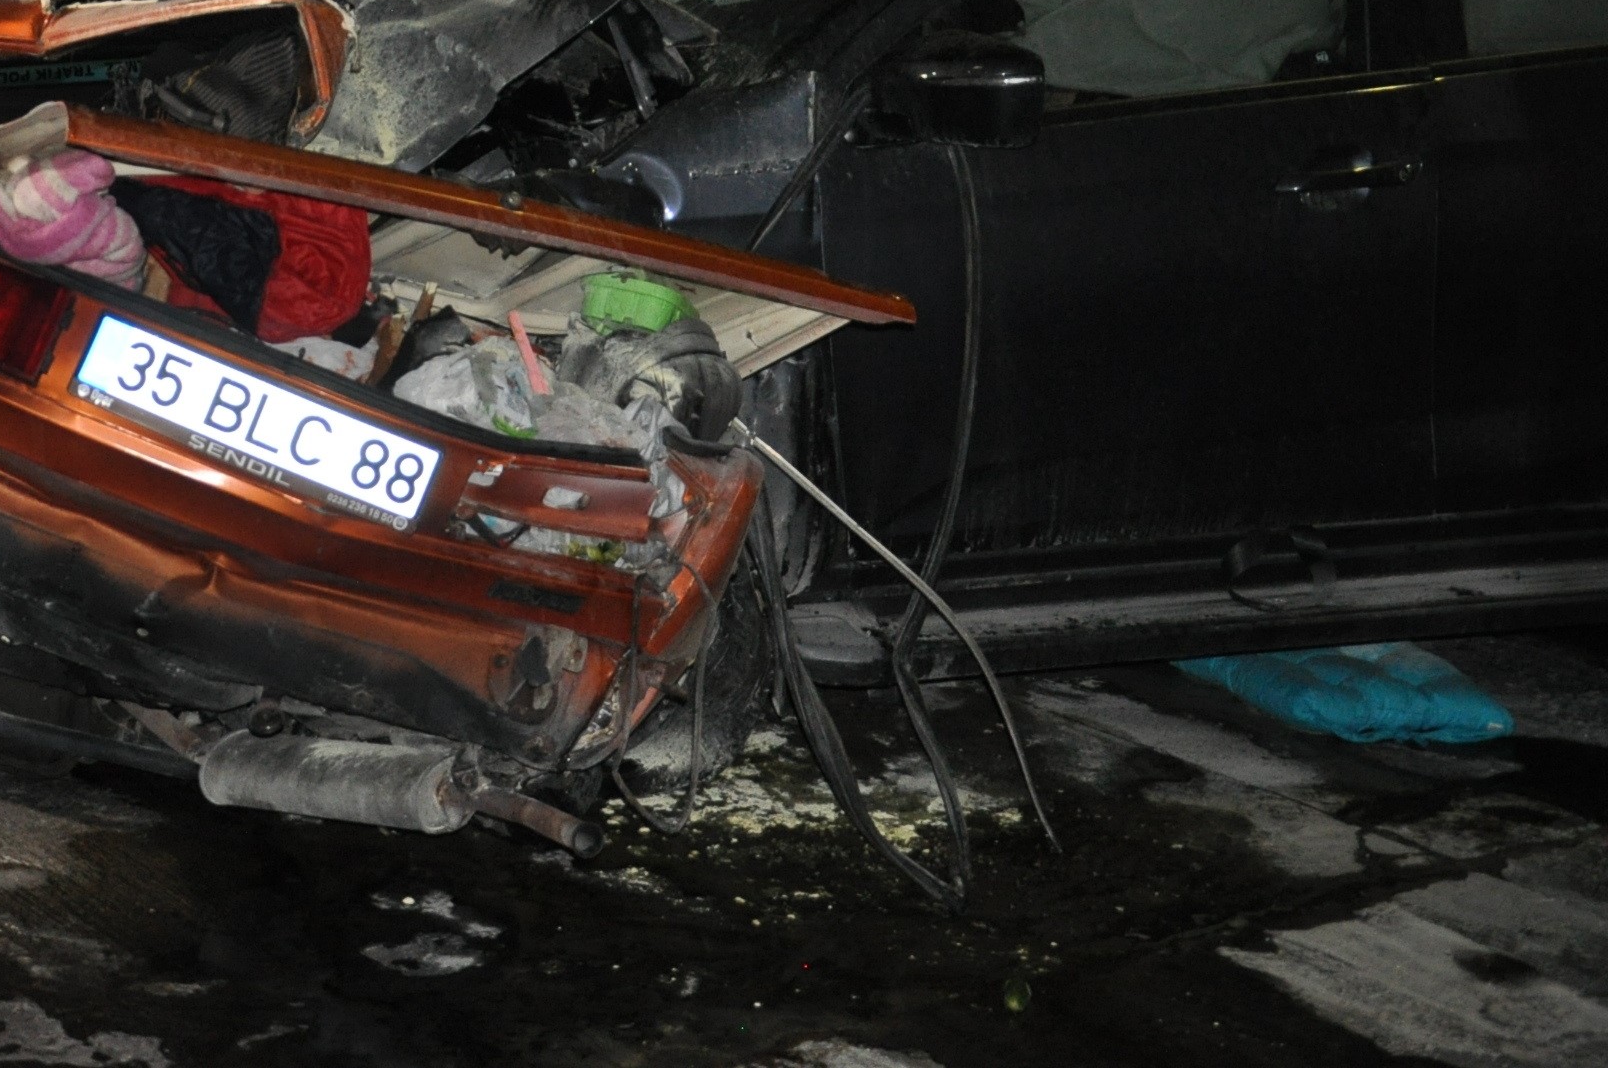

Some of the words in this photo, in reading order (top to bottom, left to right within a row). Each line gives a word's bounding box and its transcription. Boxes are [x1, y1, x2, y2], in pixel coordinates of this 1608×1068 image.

[117, 342, 193, 407] 35
[203, 376, 333, 466] BLC
[350, 439, 424, 504] 88
[187, 433, 291, 487] SENDIL
